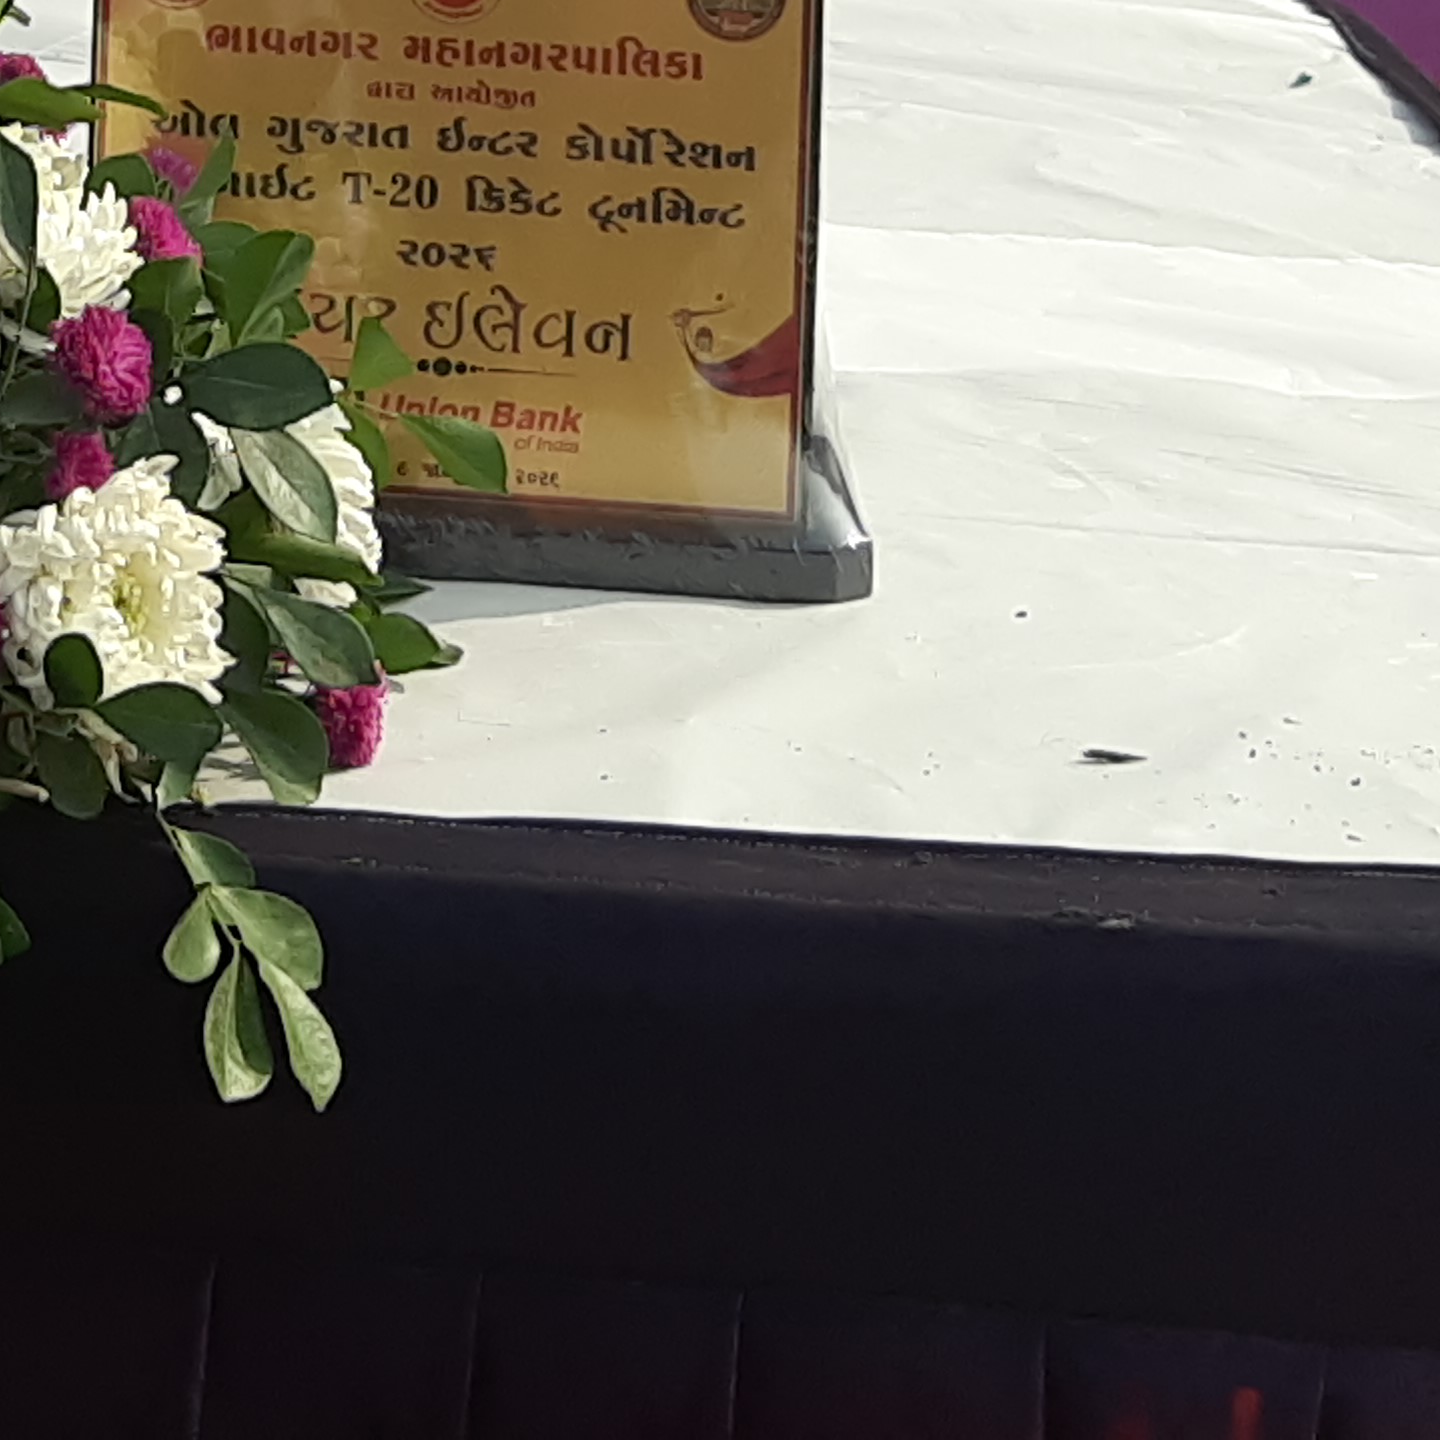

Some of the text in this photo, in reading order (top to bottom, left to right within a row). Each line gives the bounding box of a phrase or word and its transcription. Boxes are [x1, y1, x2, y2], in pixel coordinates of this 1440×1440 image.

[204, 21, 704, 82] ભાવનગર મહાનગરપાલિકા
[266, 115, 410, 154] ગુજરાત
[341, 171, 439, 209] T-20
[489, 400, 583, 435] Bank
